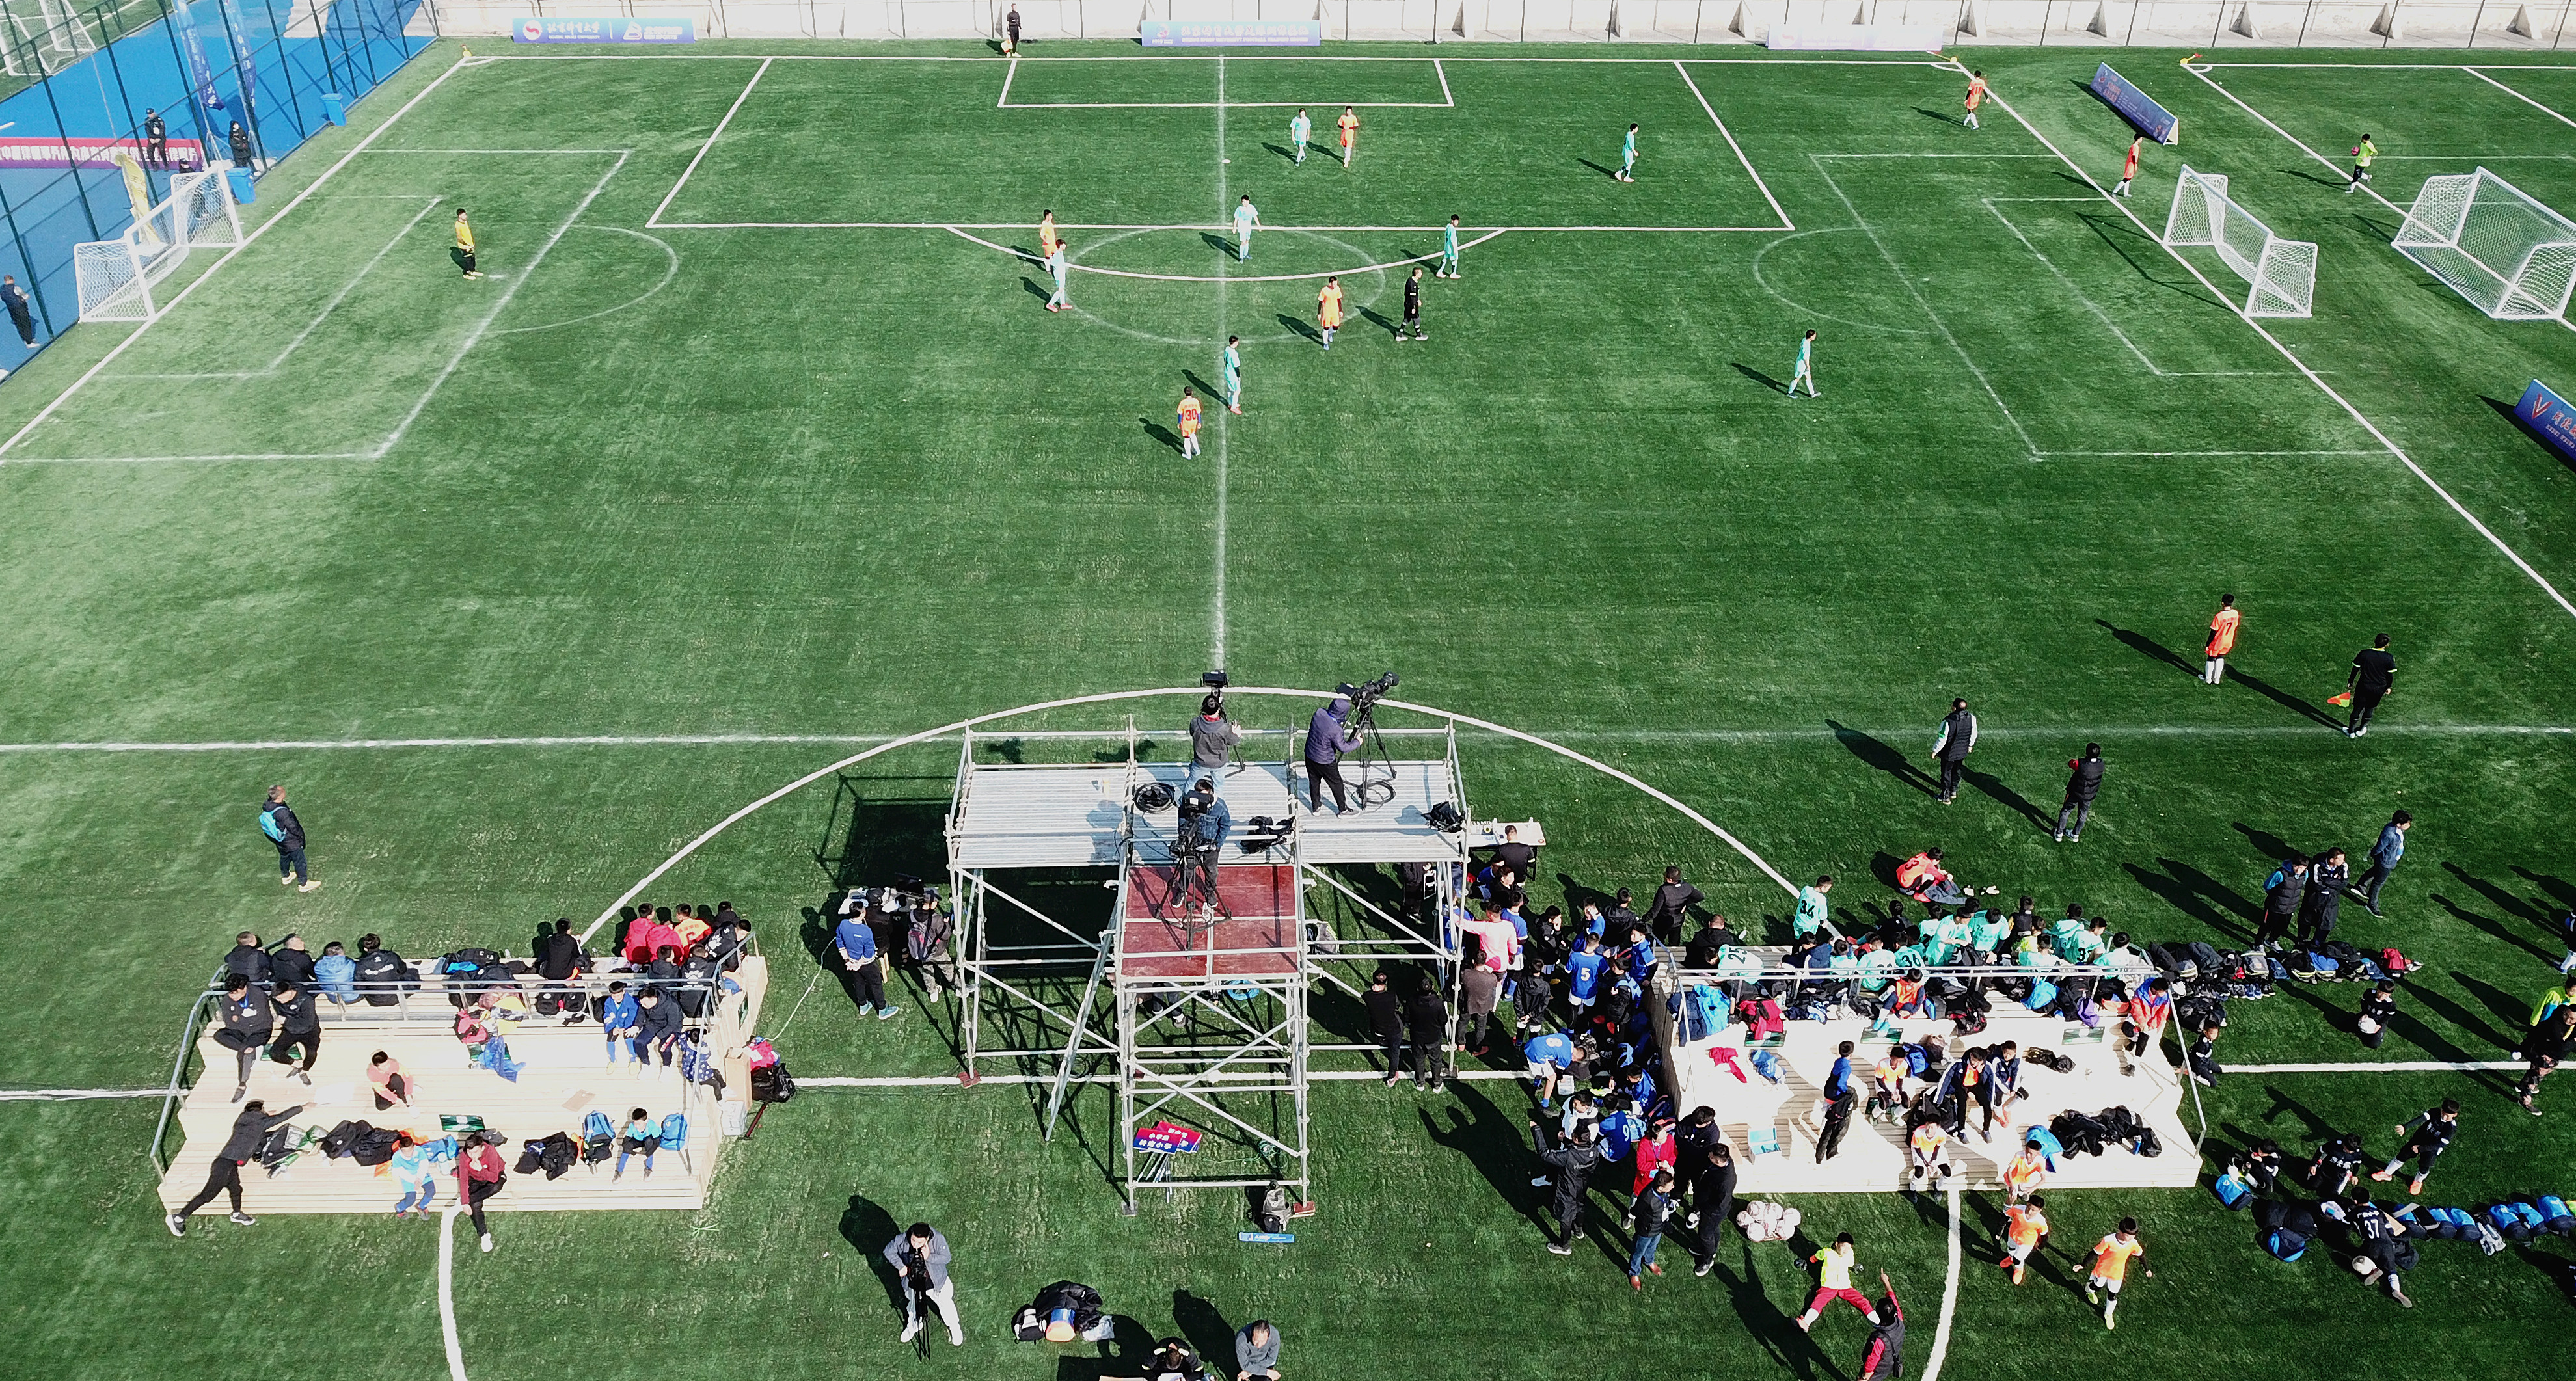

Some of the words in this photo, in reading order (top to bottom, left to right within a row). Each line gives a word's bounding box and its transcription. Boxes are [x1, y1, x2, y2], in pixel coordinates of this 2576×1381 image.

[1185, 409, 1197, 421] 30
[2226, 622, 2232, 636] 7
[1800, 900, 1815, 918] 34
[1728, 947, 1748, 964] 25
[1901, 954, 1921, 967] 36
[1580, 967, 1590, 982] 5
[1623, 1125, 1630, 1142] 9
[2364, 1218, 2380, 1239] 37
